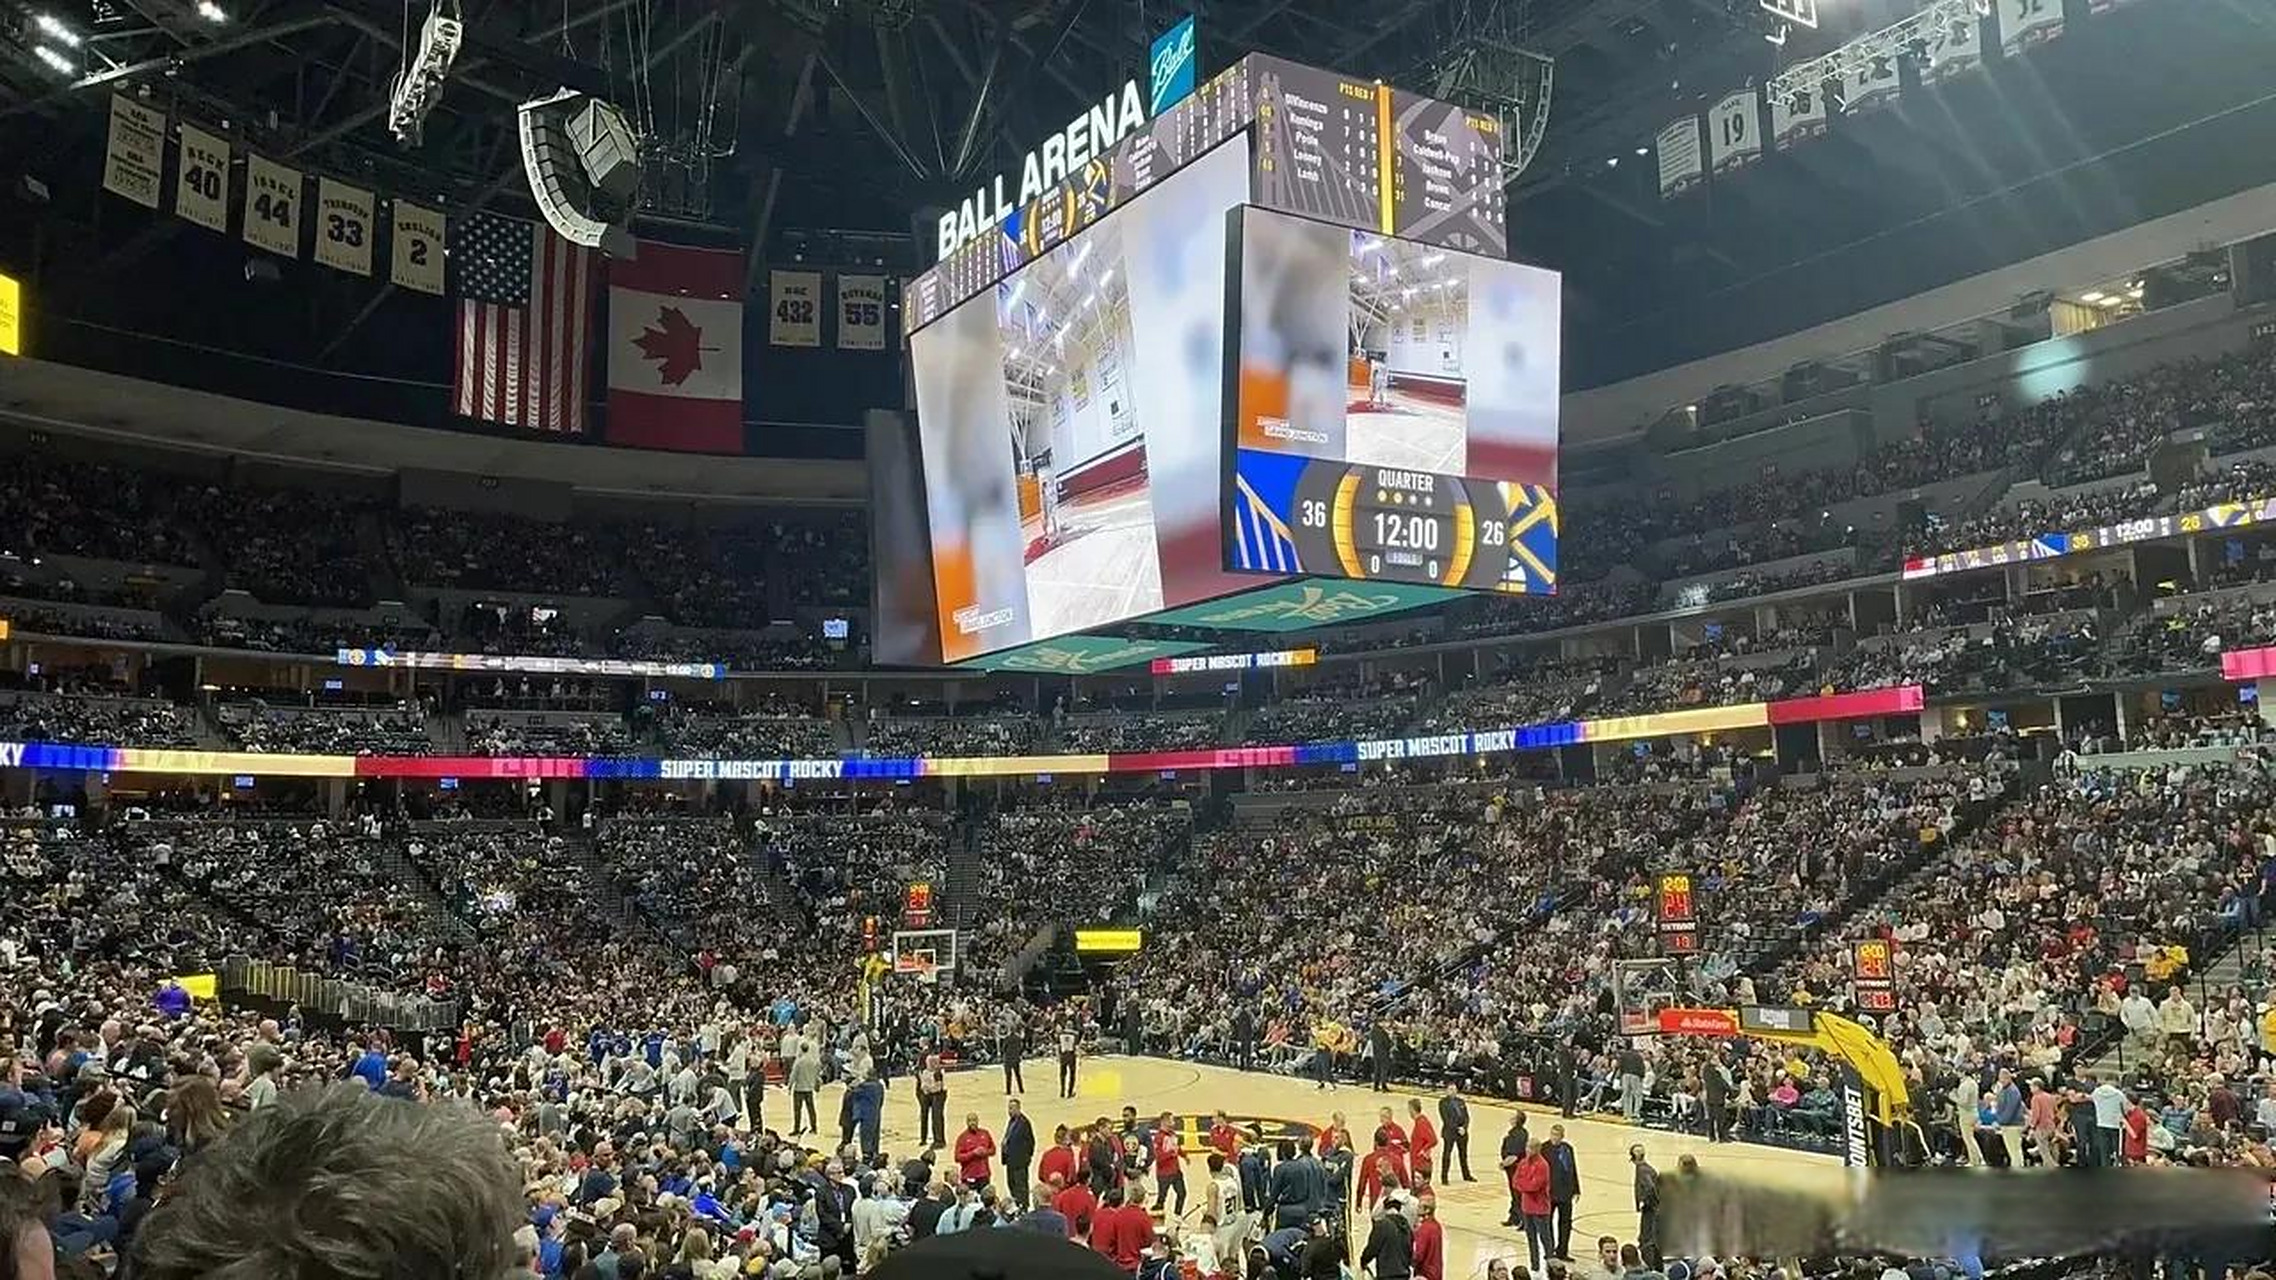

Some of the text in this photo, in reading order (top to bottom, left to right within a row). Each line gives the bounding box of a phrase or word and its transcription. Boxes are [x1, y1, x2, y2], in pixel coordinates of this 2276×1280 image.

[1296, 131, 1318, 146] Poole
[1724, 114, 1745, 146] 19
[939, 174, 1013, 261] BALL
[1019, 78, 1144, 207] ARENA
[1294, 149, 1322, 168] Looney
[185, 164, 220, 200] 40
[1297, 168, 1320, 182] Lamb
[254, 194, 290, 228] 44
[328, 214, 364, 248] 33
[410, 239, 428, 266] 2
[777, 300, 814, 324] 432
[844, 303, 880, 326] 55
[1378, 470, 1434, 492] QUARTER
[1302, 500, 1504, 550] 36 12:00 26
[2116, 518, 2154, 538] 12:00
[2180, 515, 2201, 532] 26
[1371, 555, 1380, 574] 0
[1428, 560, 1438, 579] 0
[1172, 657, 1206, 672] SUPER
[1208, 654, 1252, 670] MASCOT
[1256, 650, 1294, 668] ROCKY
[1358, 730, 1516, 760] SUPER MASCOT ROCKY
[661, 760, 844, 778] SUPER MASCOT ROCKY
[1665, 893, 1688, 918] 24
